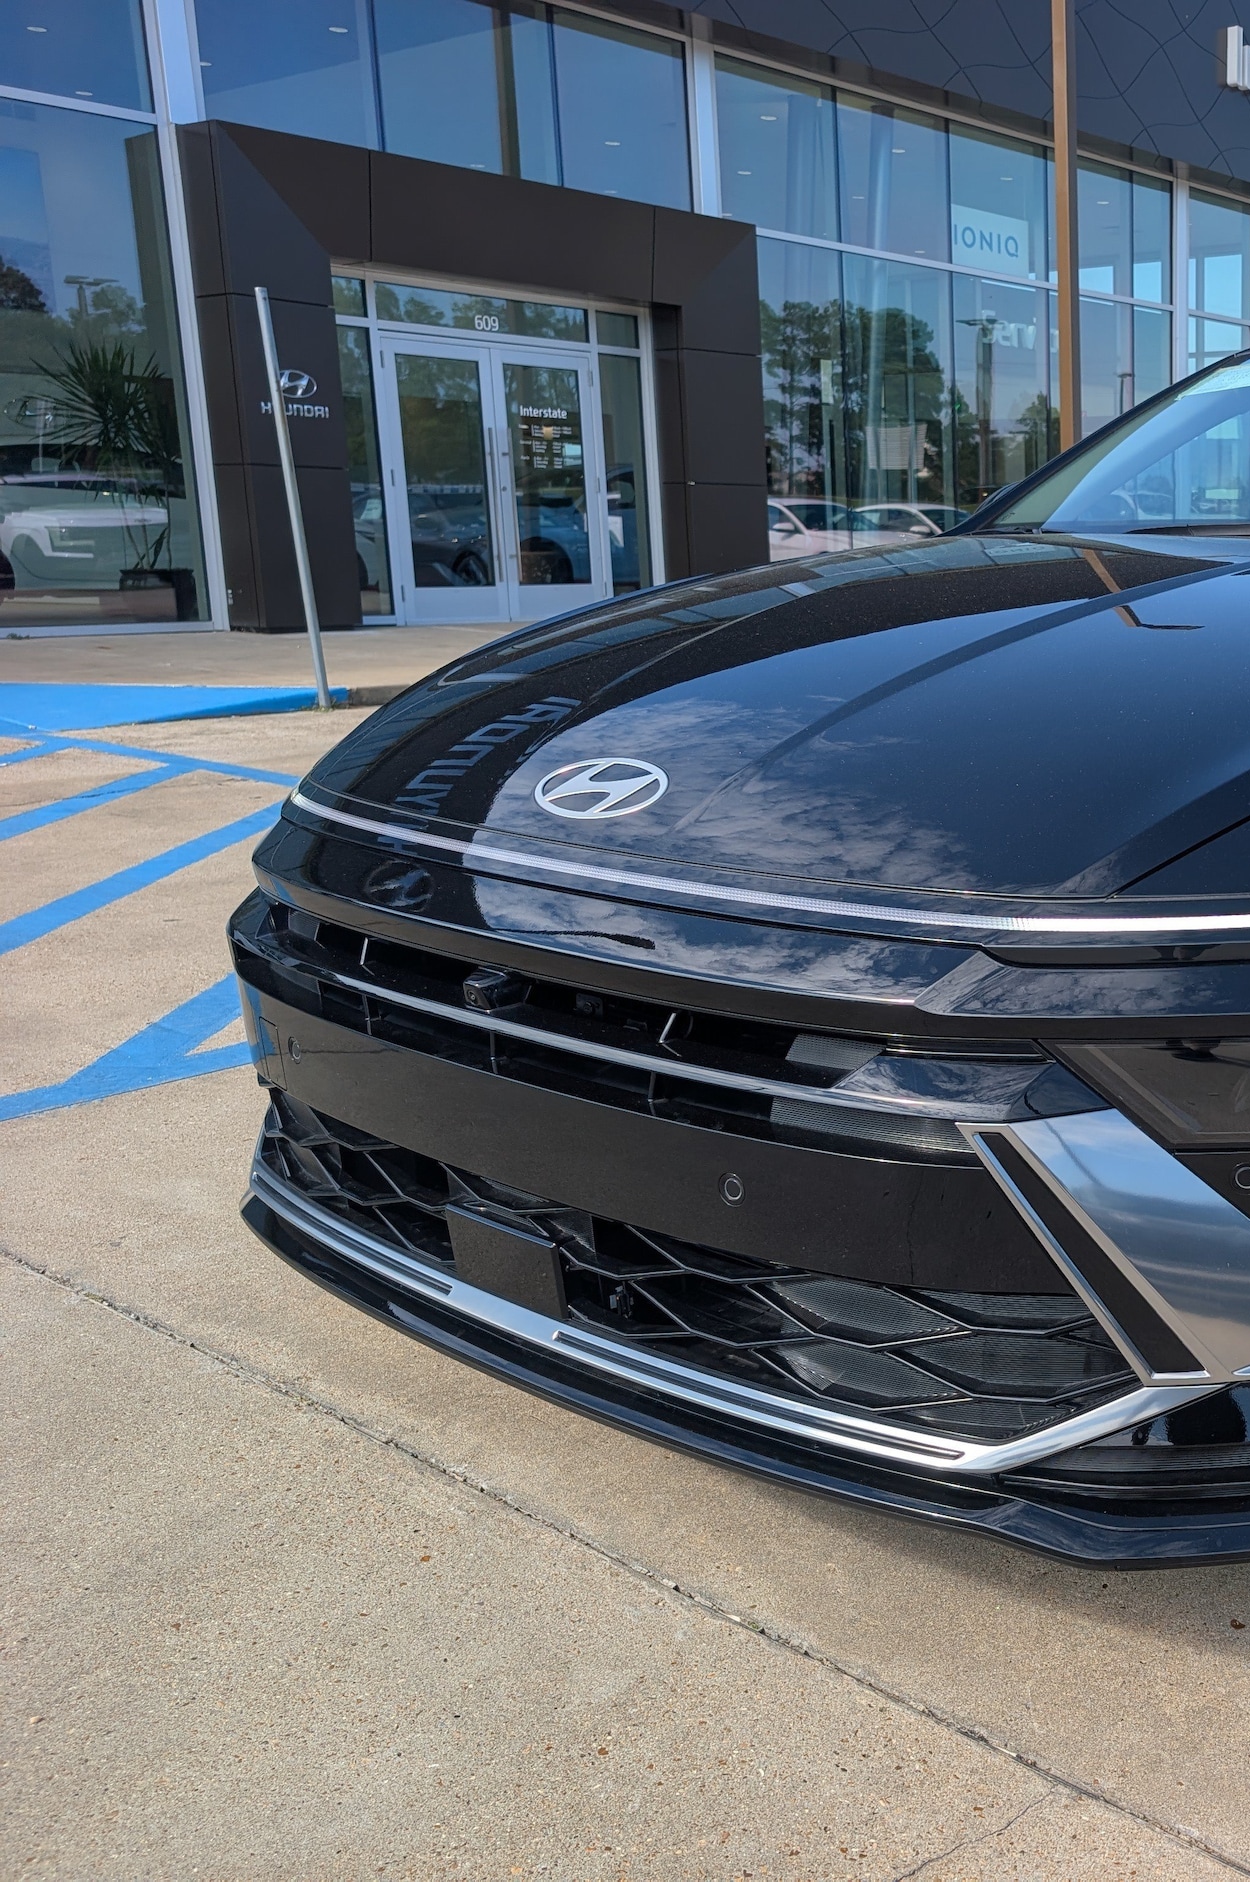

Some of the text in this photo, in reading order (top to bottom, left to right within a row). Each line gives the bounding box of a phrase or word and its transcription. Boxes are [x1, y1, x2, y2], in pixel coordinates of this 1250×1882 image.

[953, 224, 1019, 258] IONIQ
[475, 315, 499, 331] 609
[260, 401, 330, 418] HUNDAI
[520, 405, 567, 419] Interstate
